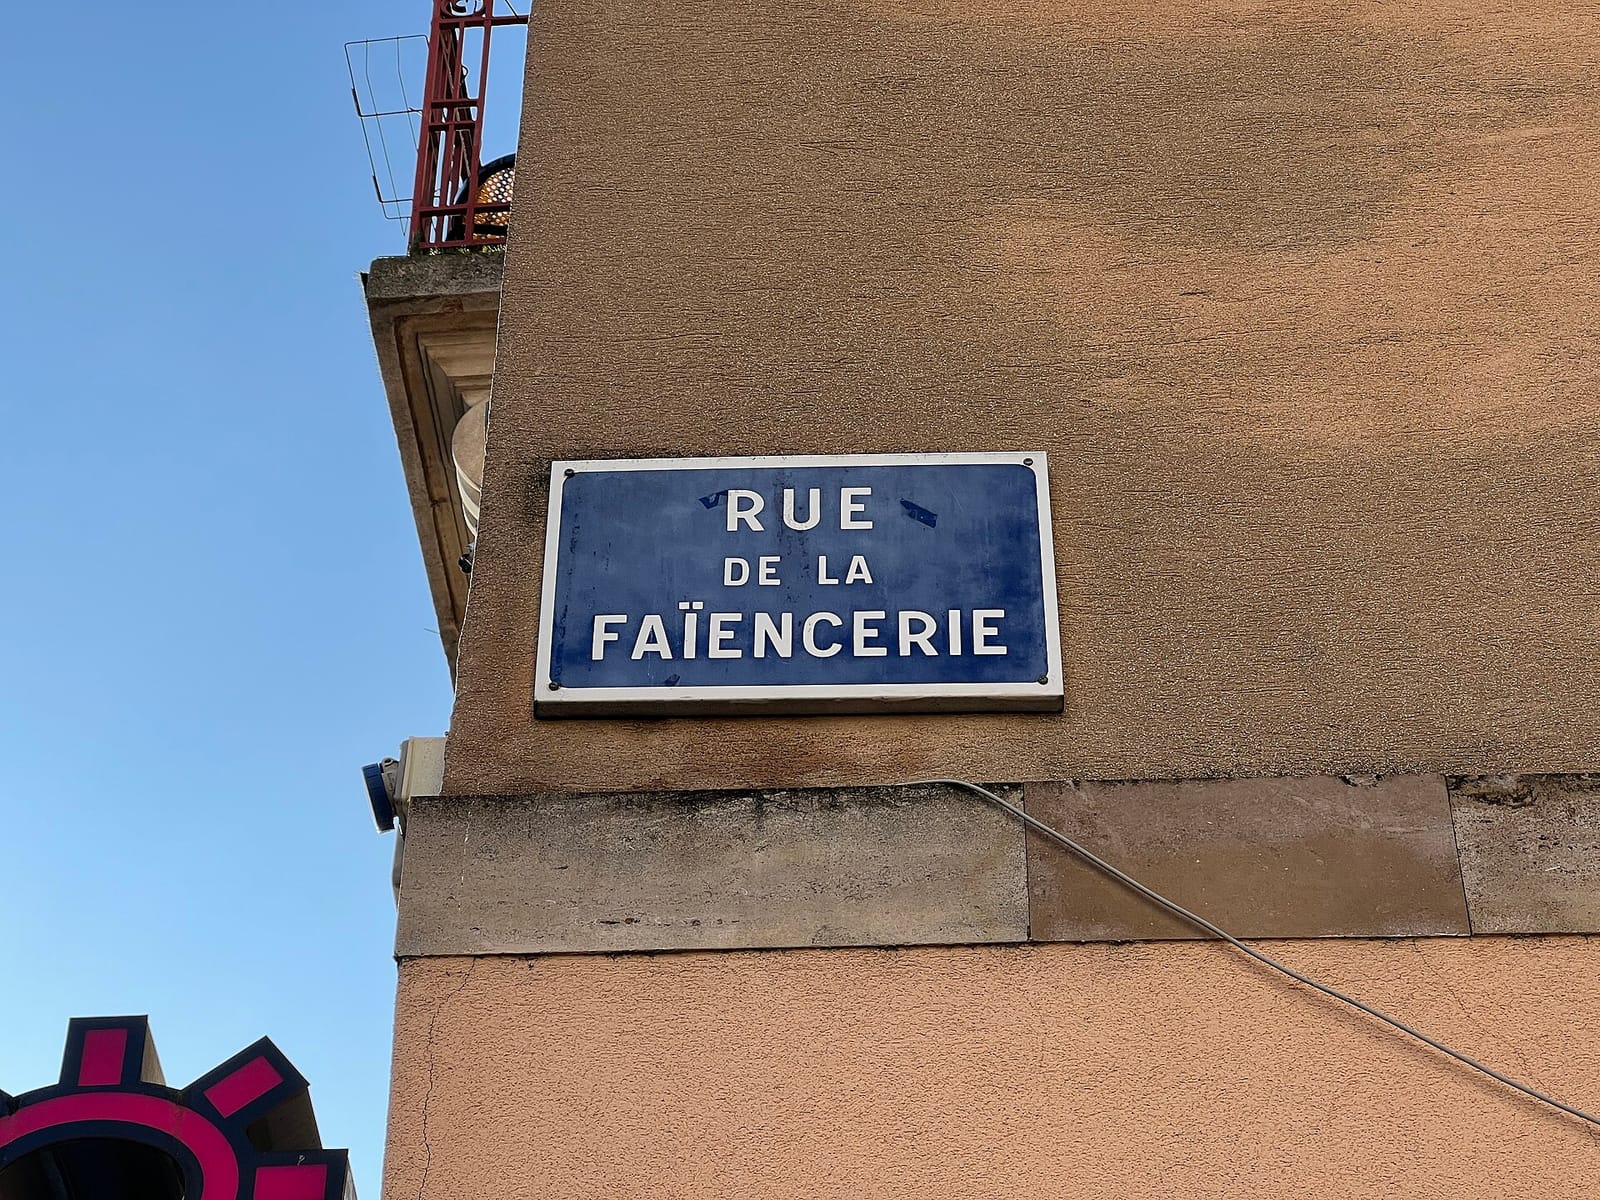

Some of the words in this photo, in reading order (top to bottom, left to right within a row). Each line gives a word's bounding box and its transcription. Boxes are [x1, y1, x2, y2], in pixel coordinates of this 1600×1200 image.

[725, 486, 875, 533] RUE
[722, 555, 782, 587] DE
[817, 554, 874, 586] LA
[590, 601, 1009, 661] FAÏENCERIE
